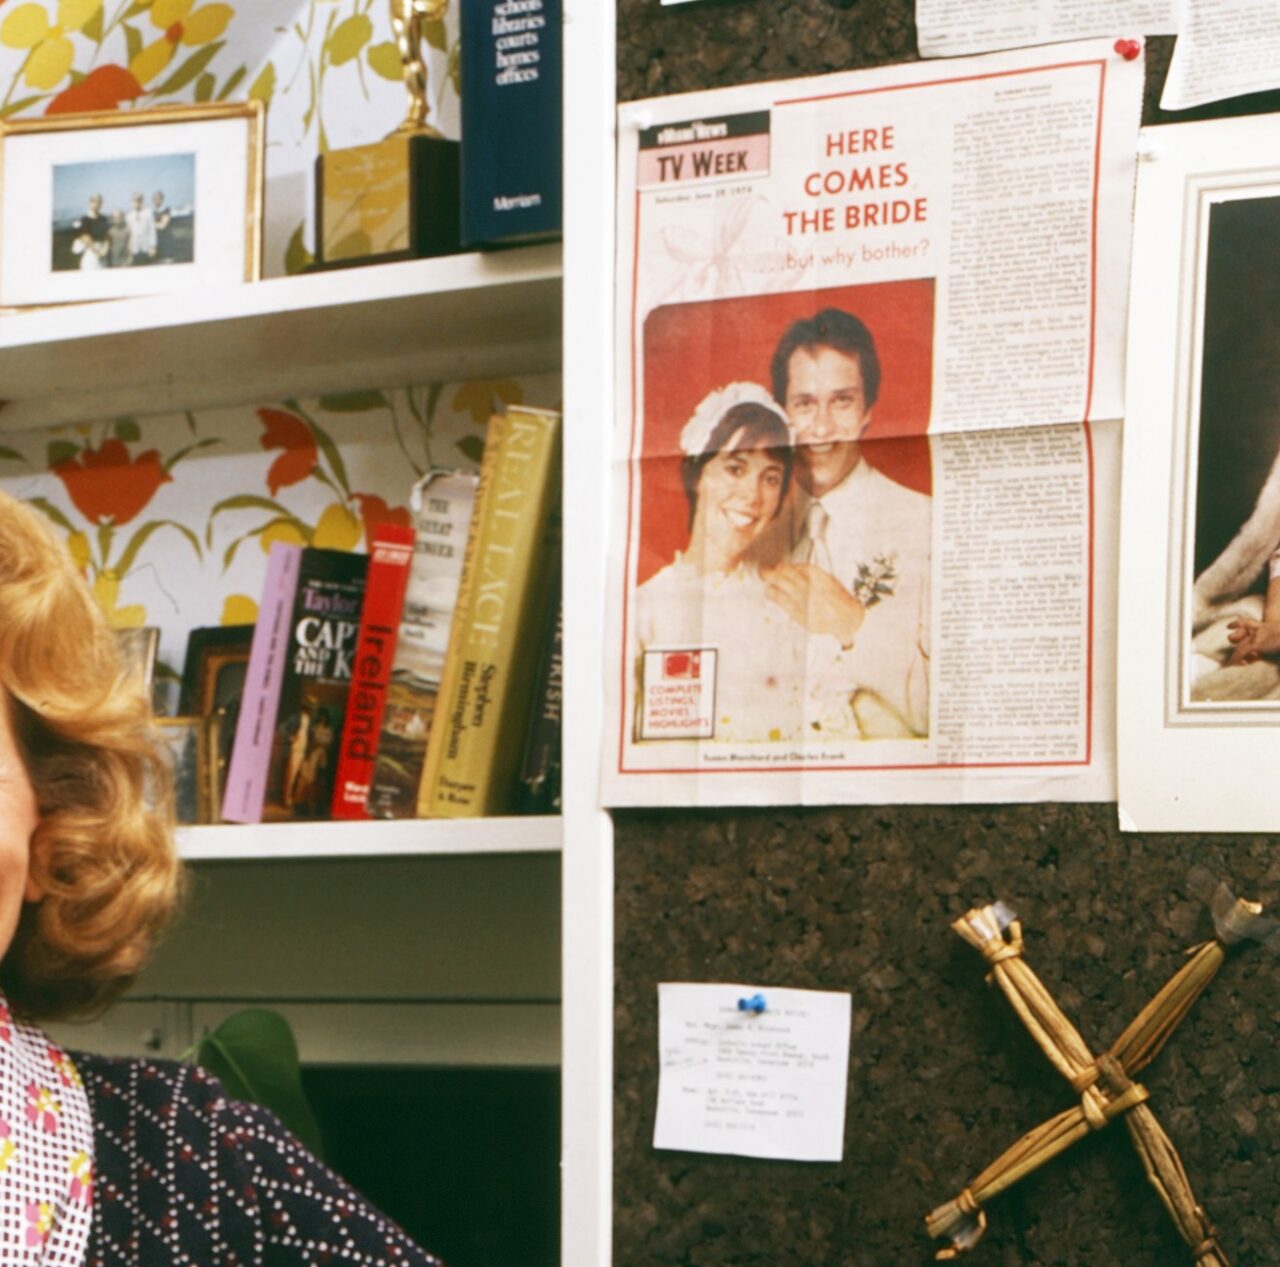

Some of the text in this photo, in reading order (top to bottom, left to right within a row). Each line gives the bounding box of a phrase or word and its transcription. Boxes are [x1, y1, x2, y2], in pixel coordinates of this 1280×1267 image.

[492, 14, 545, 35] libraries
[496, 32, 539, 50] courts
[496, 50, 540, 68] homes
[496, 65, 539, 86] offices
[825, 125, 895, 158] HERE
[657, 153, 684, 182] TV
[803, 162, 909, 197] COMES
[494, 194, 541, 210] Merriam
[783, 197, 928, 236] THE BRIDE
[821, 247, 855, 268] why
[861, 238, 930, 263] bother?
[489, 420, 540, 533] REAL
[467, 542, 514, 649] LACE
[348, 624, 394, 762] Ireland
[471, 663, 497, 728] Stephen
[447, 660, 478, 760] Birmingham
